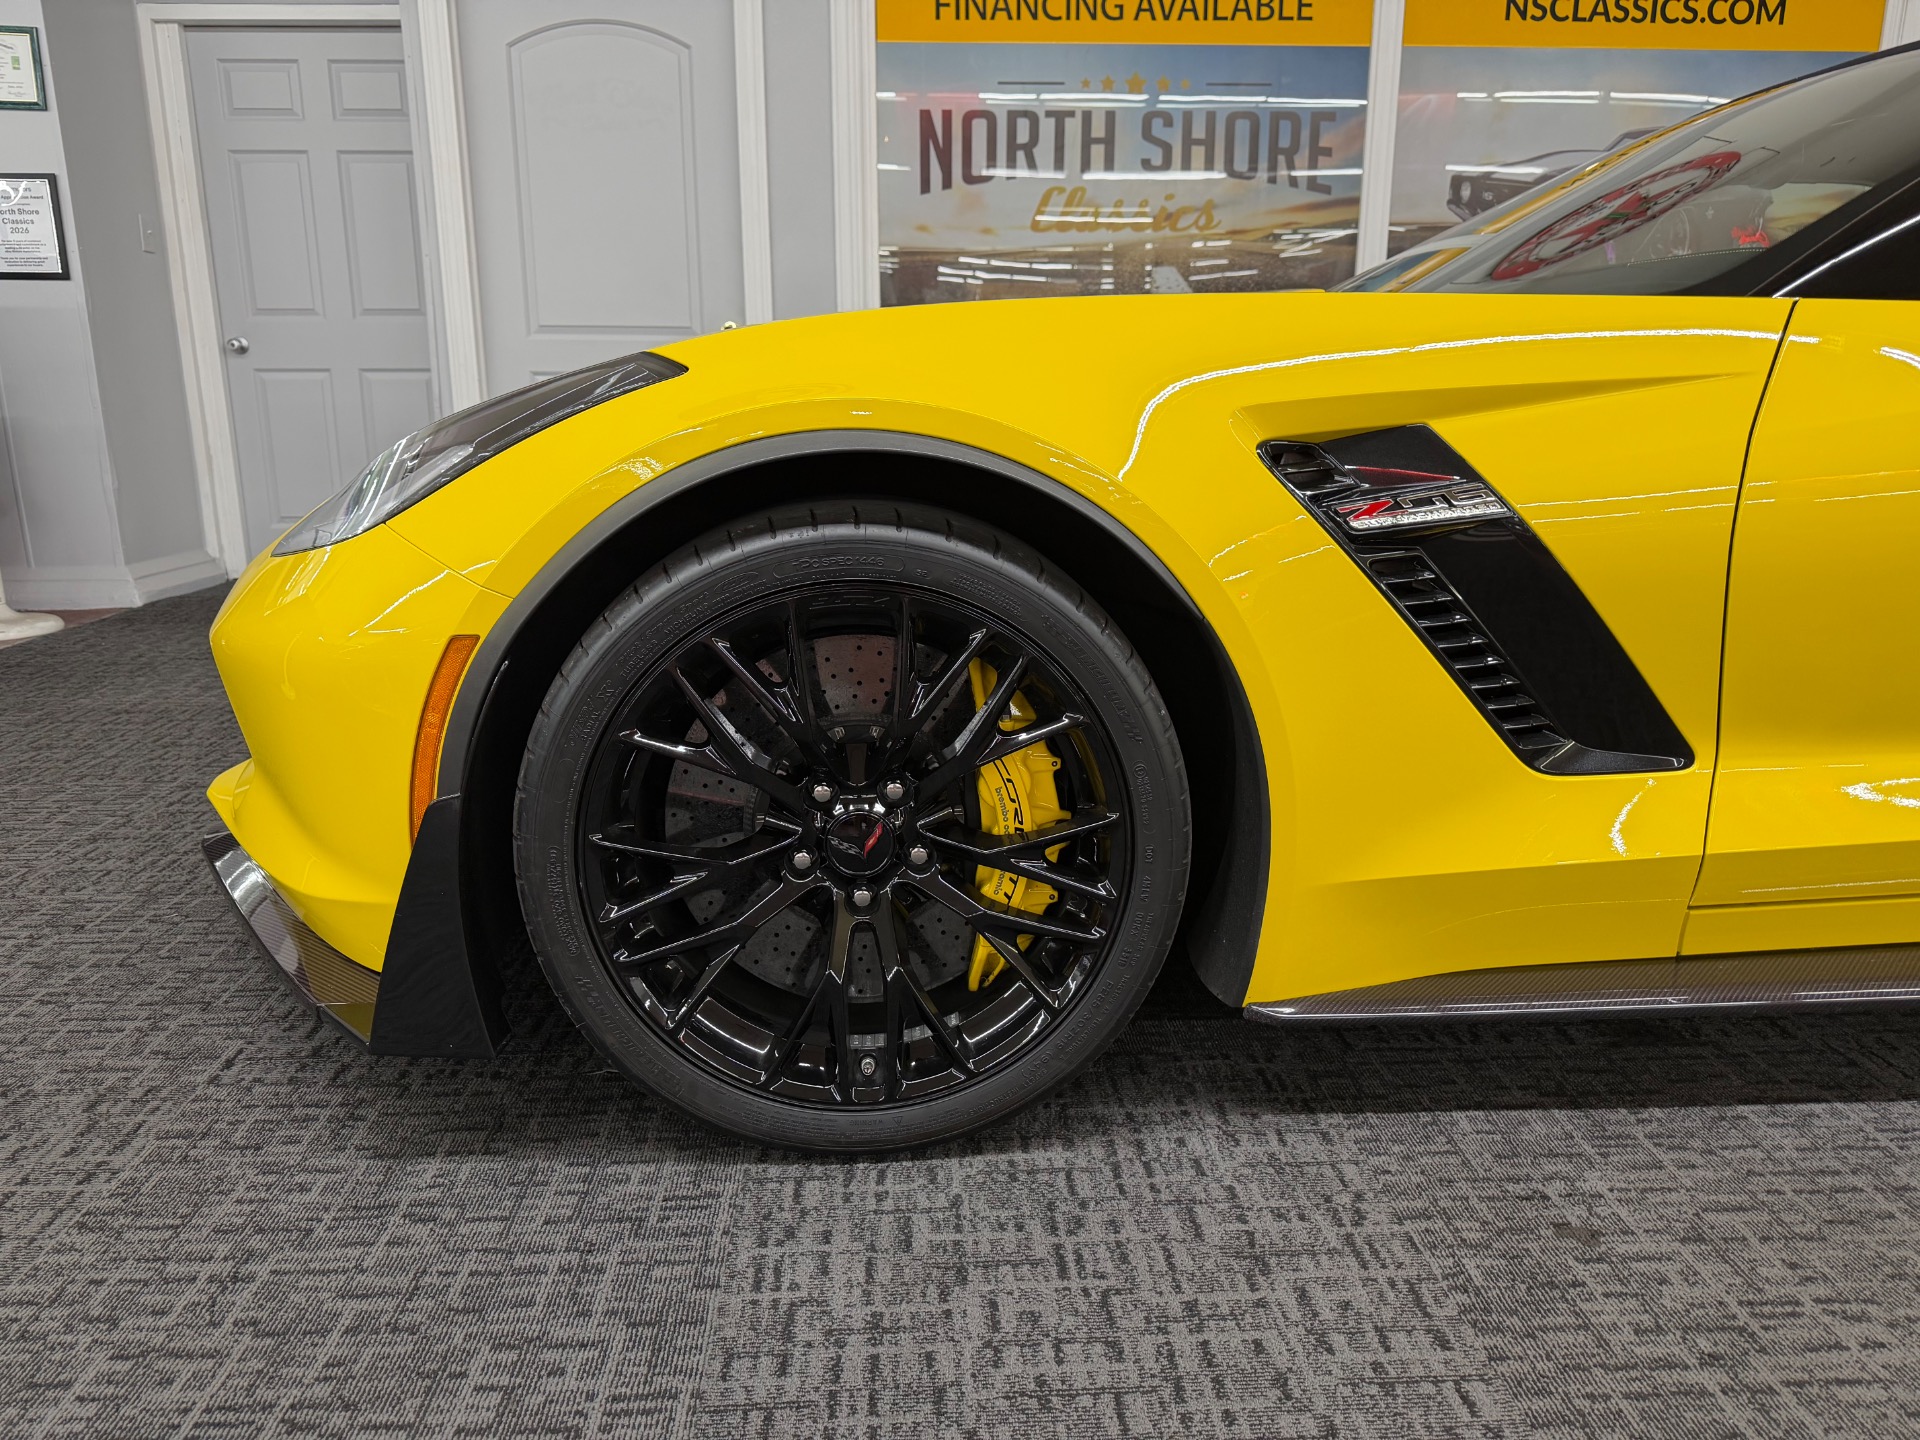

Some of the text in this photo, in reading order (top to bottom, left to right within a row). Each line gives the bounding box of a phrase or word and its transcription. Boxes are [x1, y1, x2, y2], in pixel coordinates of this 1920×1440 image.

[935, 0, 1314, 21] FINANCING AVAILABLE
[1505, 0, 1787, 25] NSCLASSICS.COM
[919, 108, 1337, 195] NORTH SHORE
[1030, 185, 1222, 234] Classics
[994, 786, 1010, 822] brembo
